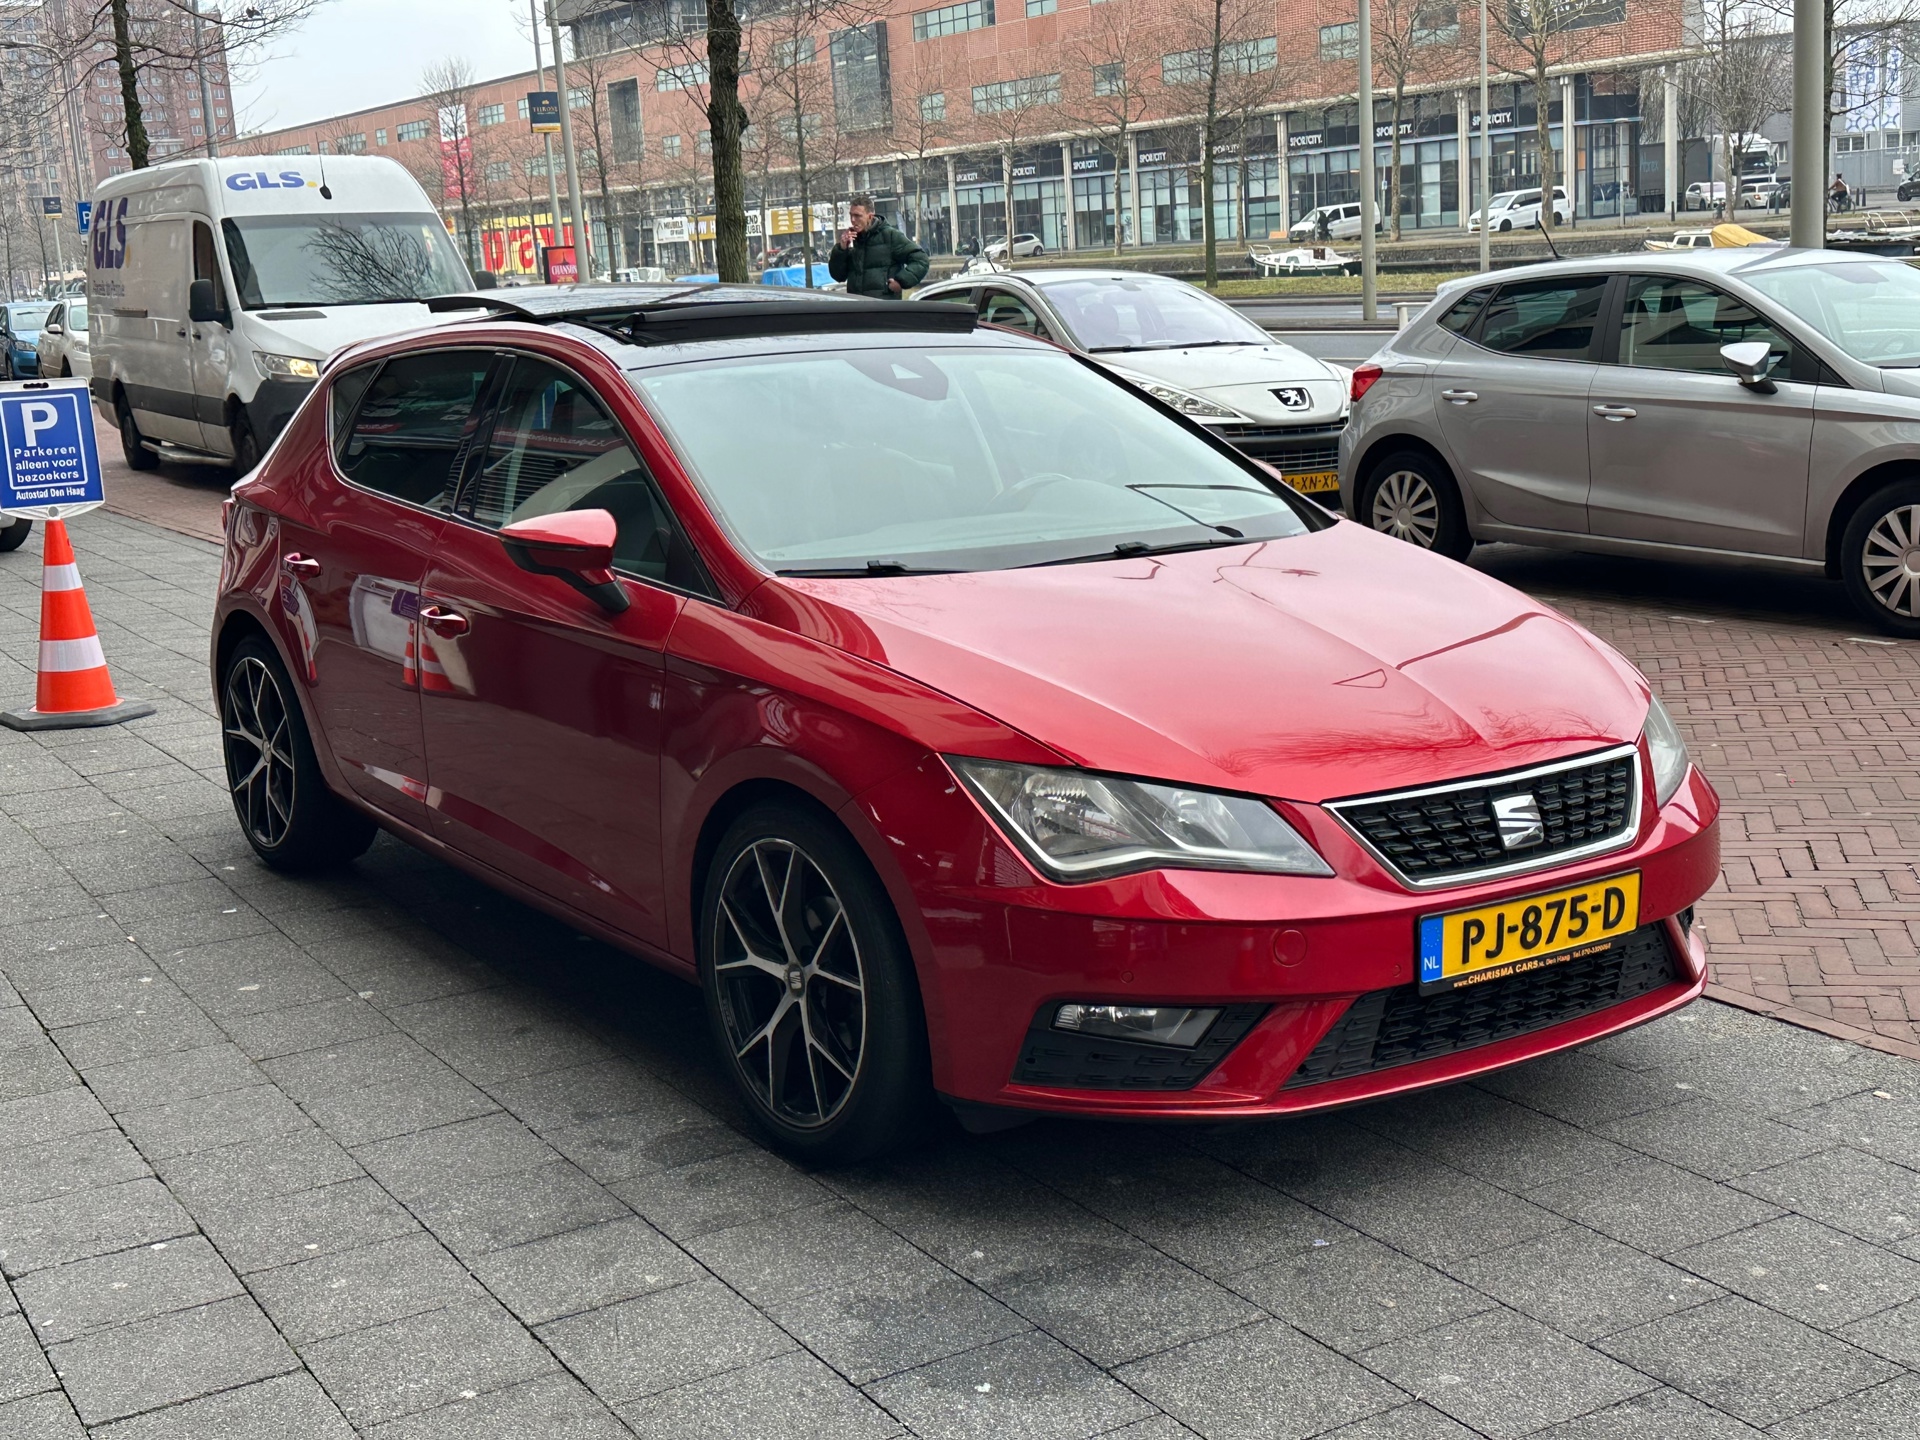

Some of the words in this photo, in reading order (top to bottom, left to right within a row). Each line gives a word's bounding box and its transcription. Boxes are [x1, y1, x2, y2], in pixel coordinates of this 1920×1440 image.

[82, 210, 91, 225] P
[20, 402, 58, 447] P
[14, 446, 76, 458] Parkeren
[15, 461, 49, 470] alleen
[51, 458, 78, 468] voor
[17, 471, 79, 482] bezoekers
[15, 489, 49, 500] Autostad
[50, 488, 65, 497] Den
[66, 487, 86, 497] Haag
[1462, 887, 1625, 964] PJ-875-D
[1423, 956, 1440, 971] NL
